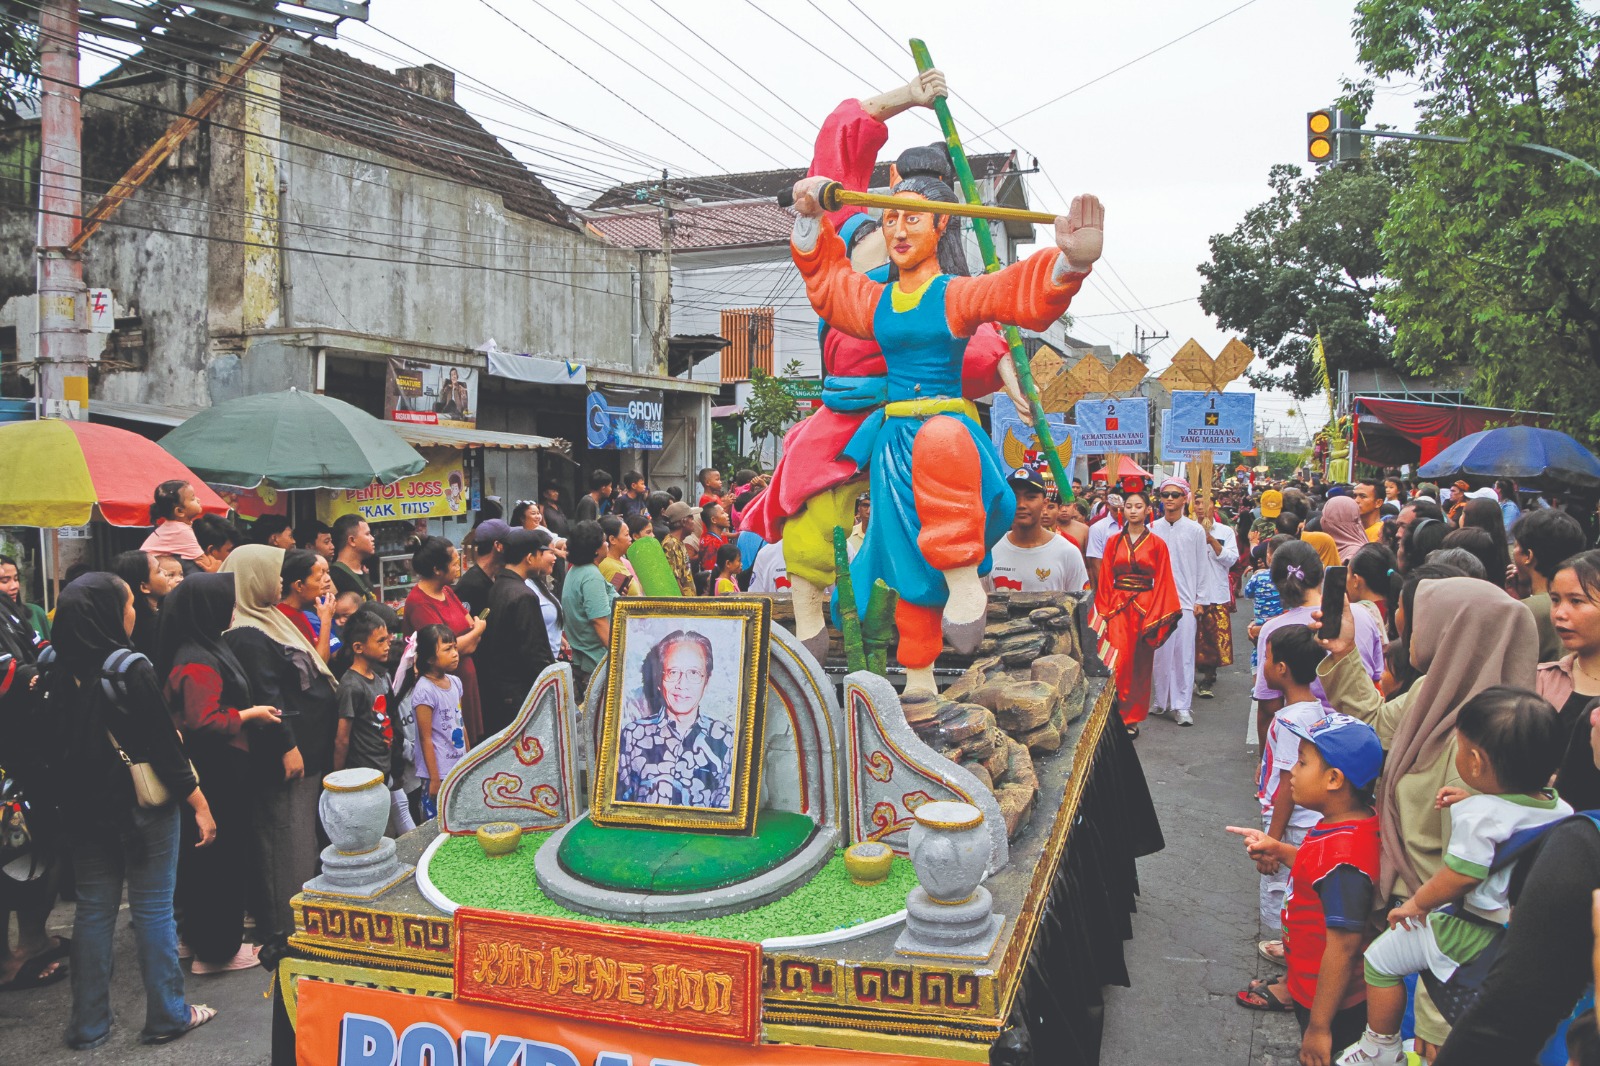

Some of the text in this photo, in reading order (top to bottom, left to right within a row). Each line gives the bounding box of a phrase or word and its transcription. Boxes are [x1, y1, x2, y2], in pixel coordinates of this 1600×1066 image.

[1209, 397, 1216, 410] 1
[628, 400, 663, 421] GROW
[1107, 404, 1116, 416] 2
[644, 420, 663, 432] BLACK
[1187, 428, 1235, 436] KETUHANAN
[651, 431, 663, 443] ICE
[1180, 435, 1200, 443] YANG
[344, 480, 443, 501] PENTOL JOSS
[473, 942, 545, 990] KHO
